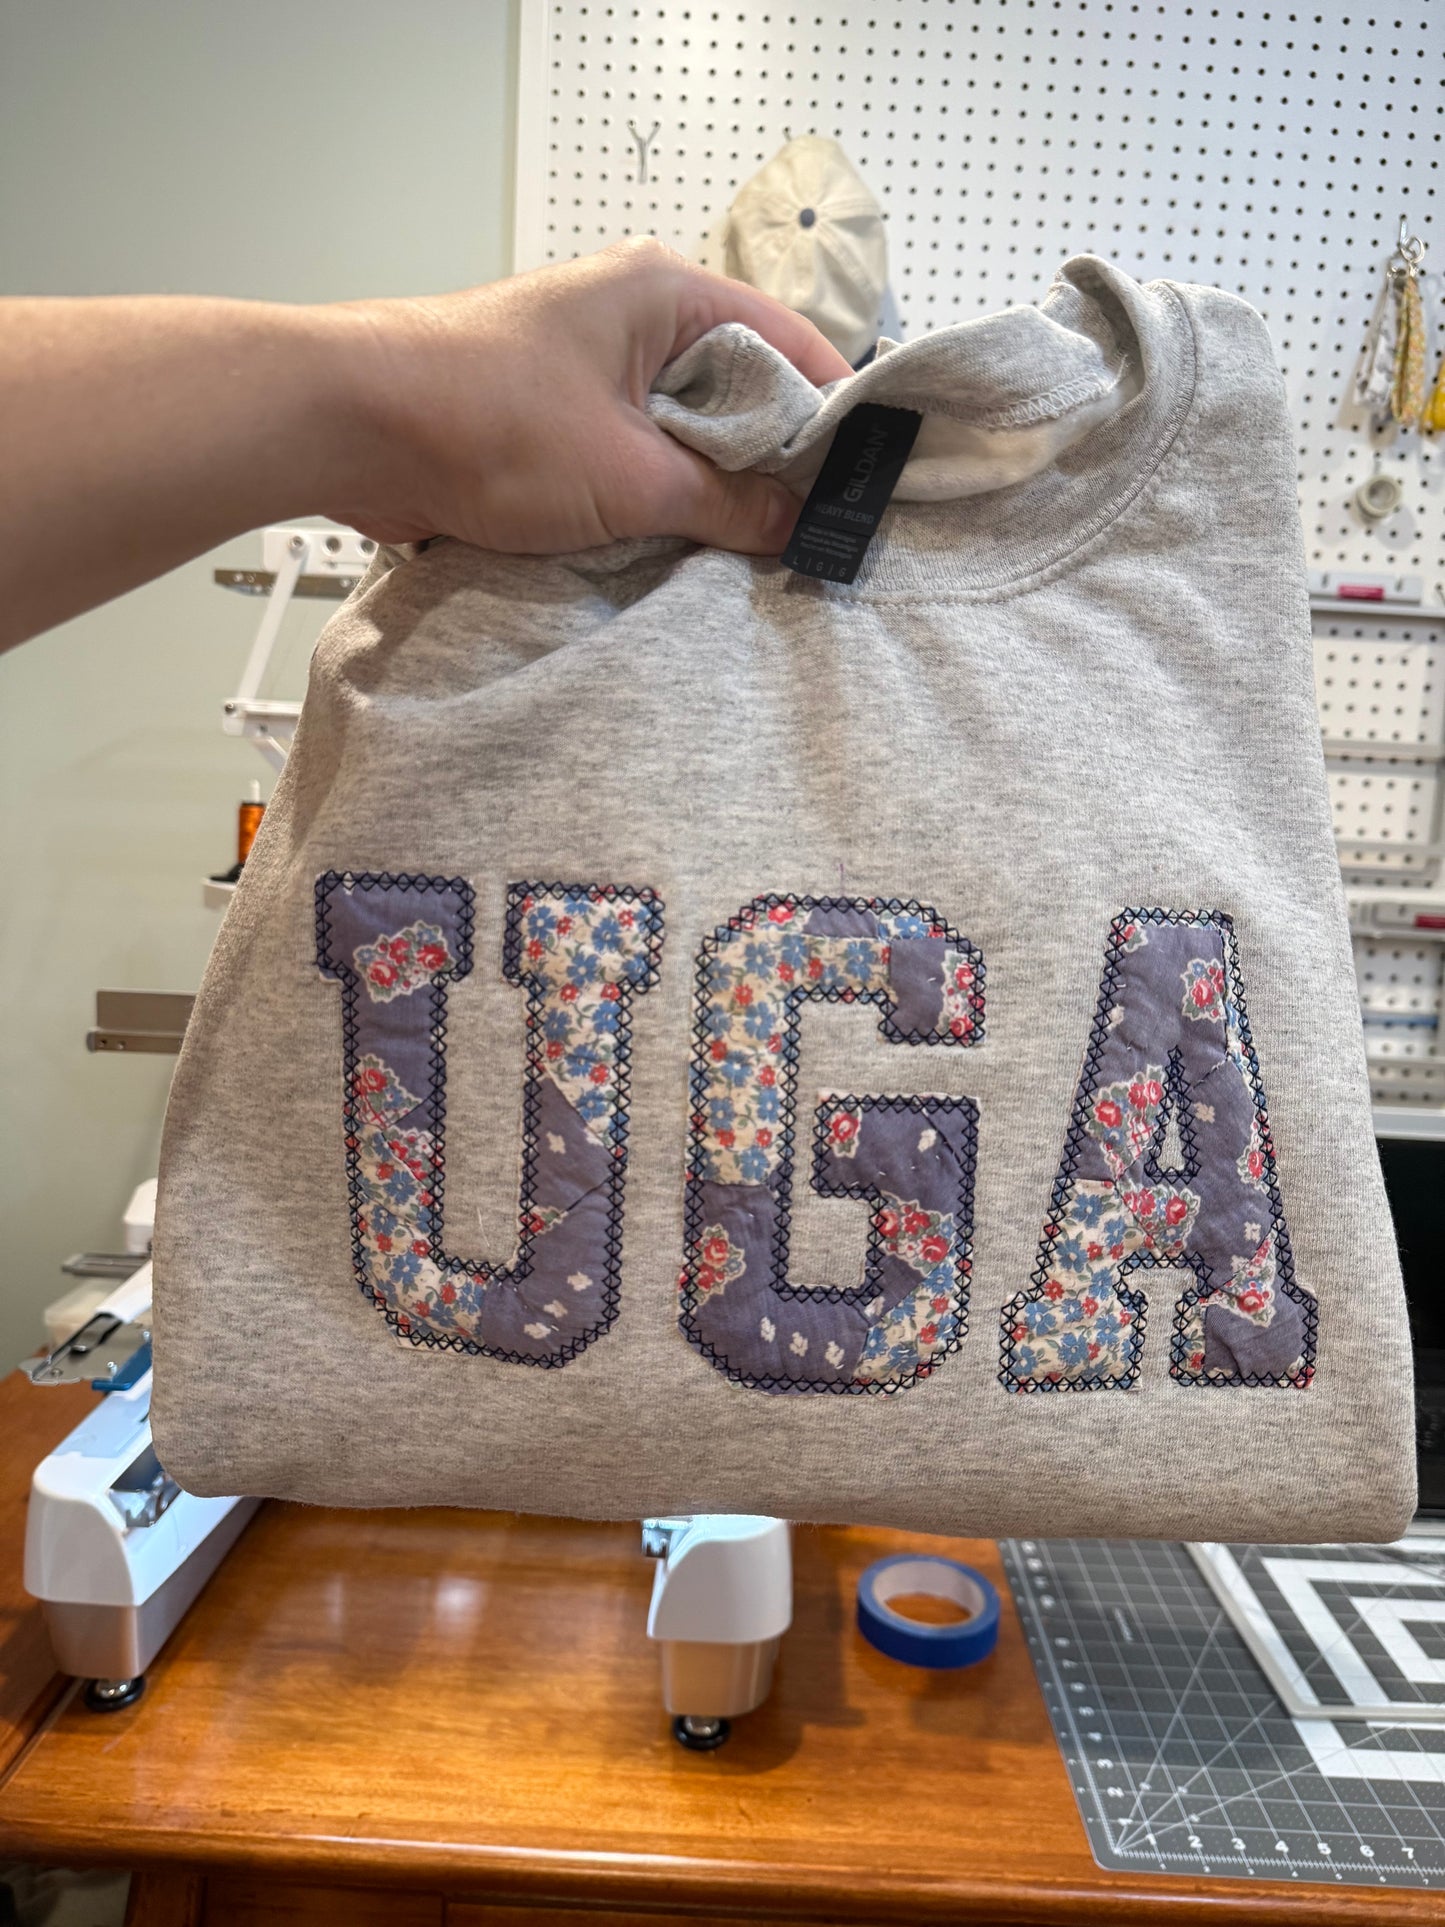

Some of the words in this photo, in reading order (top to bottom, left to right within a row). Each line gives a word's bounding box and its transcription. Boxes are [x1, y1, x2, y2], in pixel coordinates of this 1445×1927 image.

[842, 428, 888, 504] GILDAN
[844, 509, 874, 525] BLEND
[314, 870, 1318, 1395] UGA
[1096, 1758, 1114, 1769] 3
[1106, 1786, 1125, 1798] 2
[1187, 1835, 1203, 1848] 2
[1231, 1837, 1246, 1850] 3
[1274, 1840, 1289, 1853] 4
[1317, 1842, 1331, 1855] 5
[1359, 1844, 1375, 1858] 6
[1401, 1847, 1414, 1859] 7
